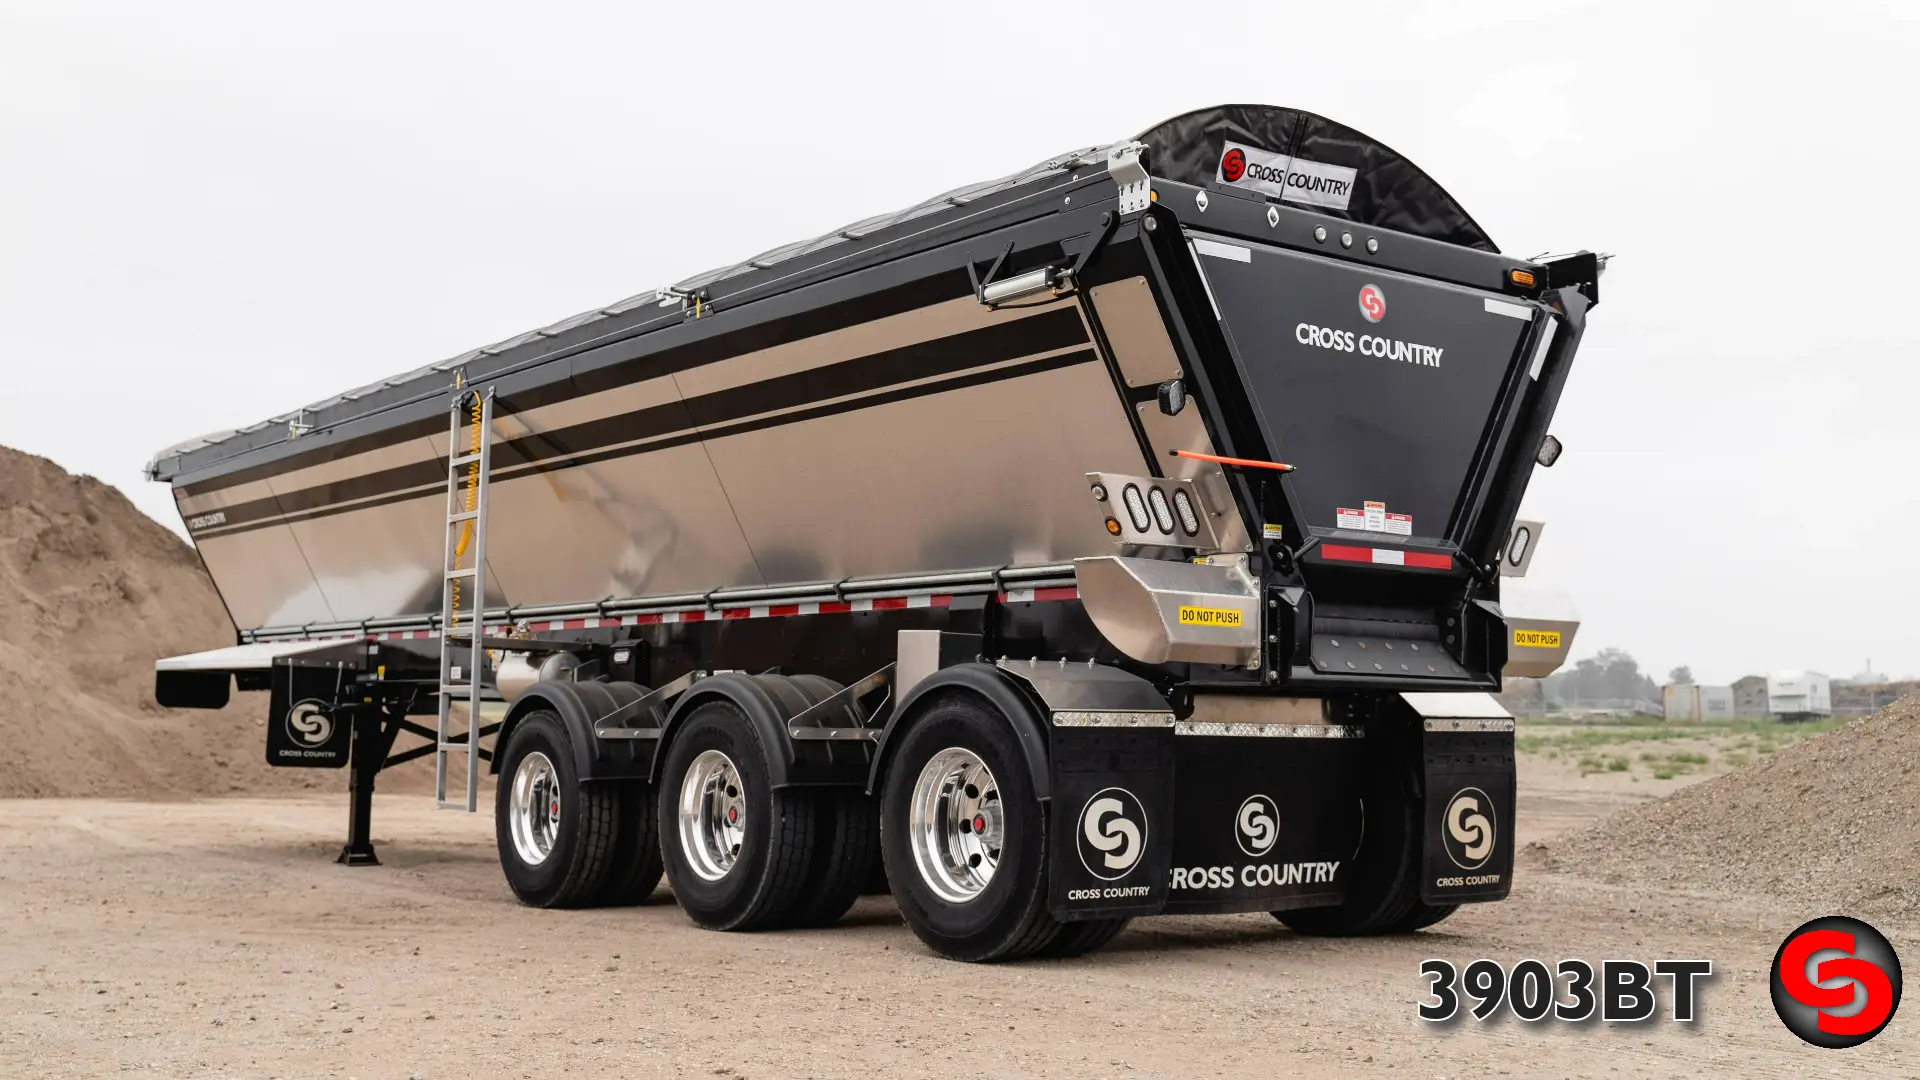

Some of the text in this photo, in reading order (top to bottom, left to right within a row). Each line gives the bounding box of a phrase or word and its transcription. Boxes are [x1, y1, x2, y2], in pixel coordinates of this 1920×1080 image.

[1247, 162, 1350, 196] CROSS COUNTRY
[1295, 322, 1444, 368] CROSS COUNTRY
[1182, 609, 1239, 624] DO NOT PUSH
[1516, 633, 1558, 645] DO NOT PUSH
[279, 749, 336, 758] CROSS COUNTRY
[1168, 861, 1340, 890] ROSS COUNTRY
[1436, 874, 1500, 888] CROSS COUNTRY
[1067, 885, 1150, 900] CROSS COUNTRY
